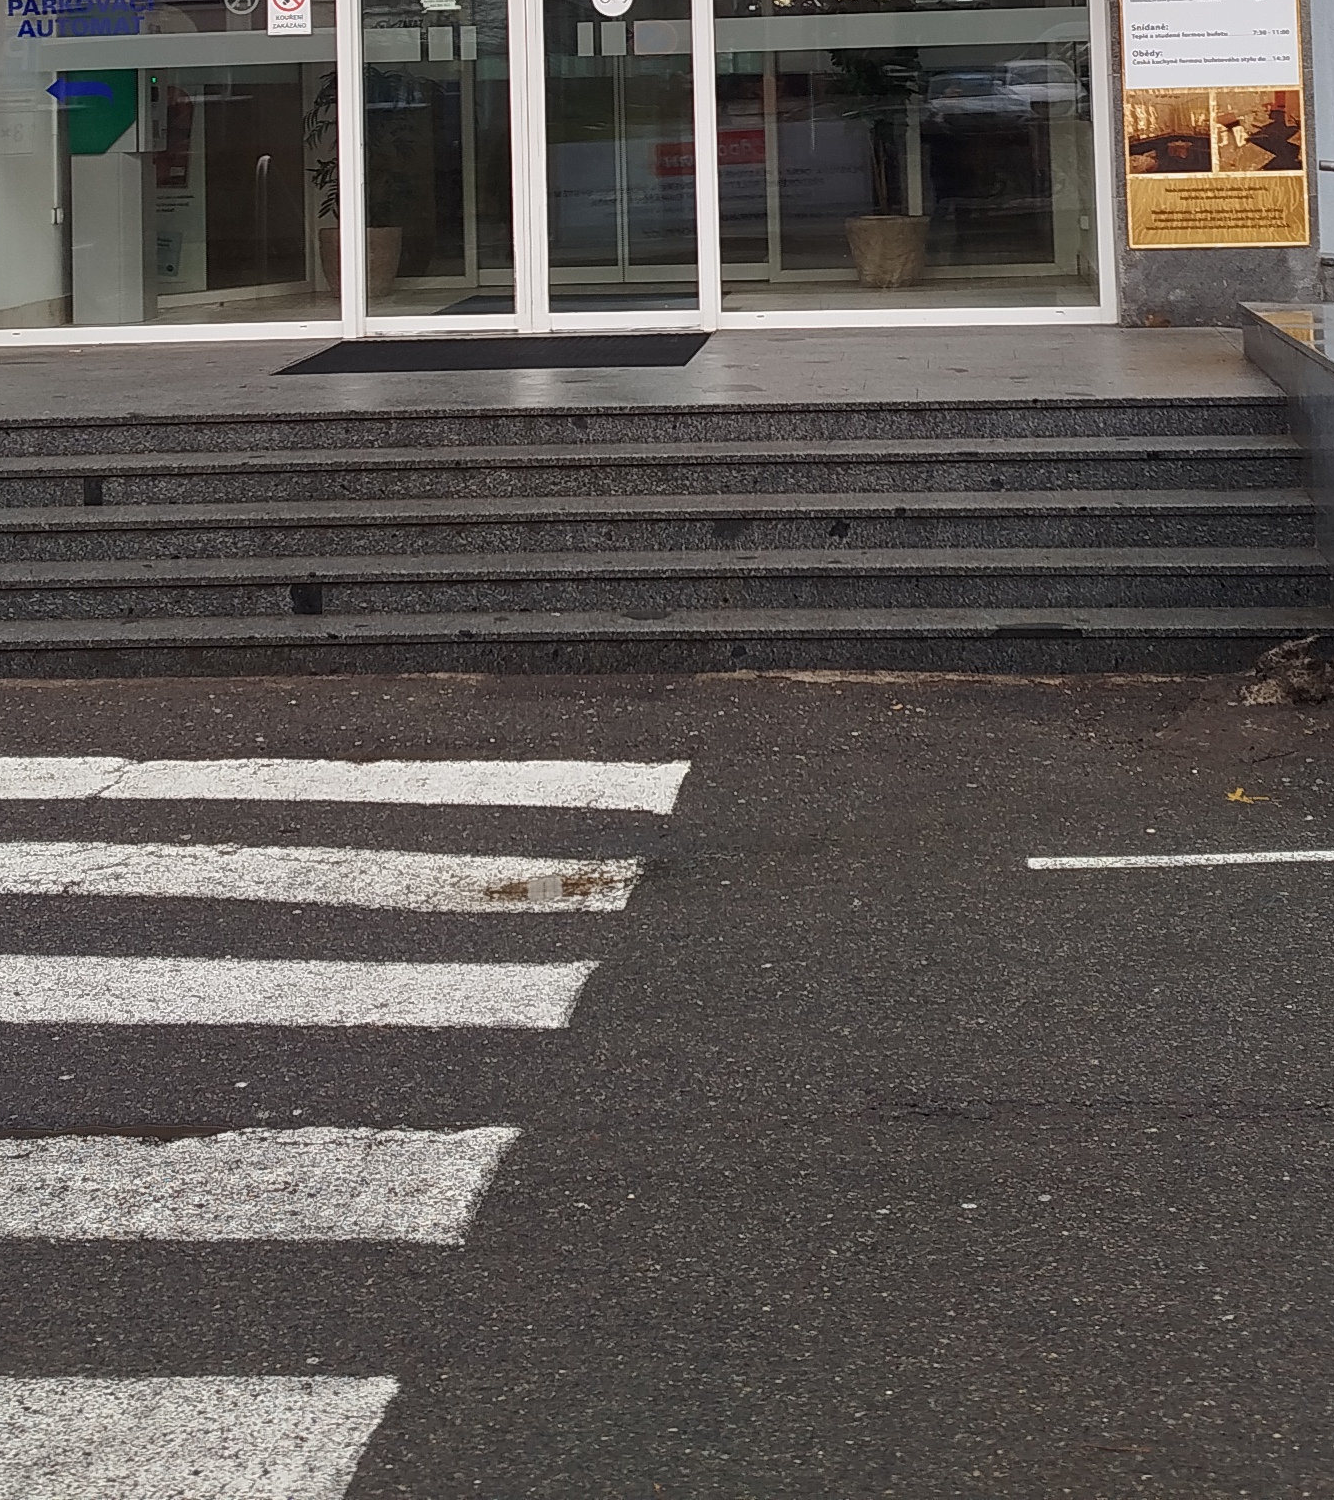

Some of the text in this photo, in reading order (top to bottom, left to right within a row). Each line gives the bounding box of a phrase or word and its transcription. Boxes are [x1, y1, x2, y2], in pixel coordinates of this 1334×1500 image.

[17, 15, 145, 38] AUTOMAT
[1131, 23, 1169, 32] Snídaně:
[1132, 50, 1163, 58] Obědy:
